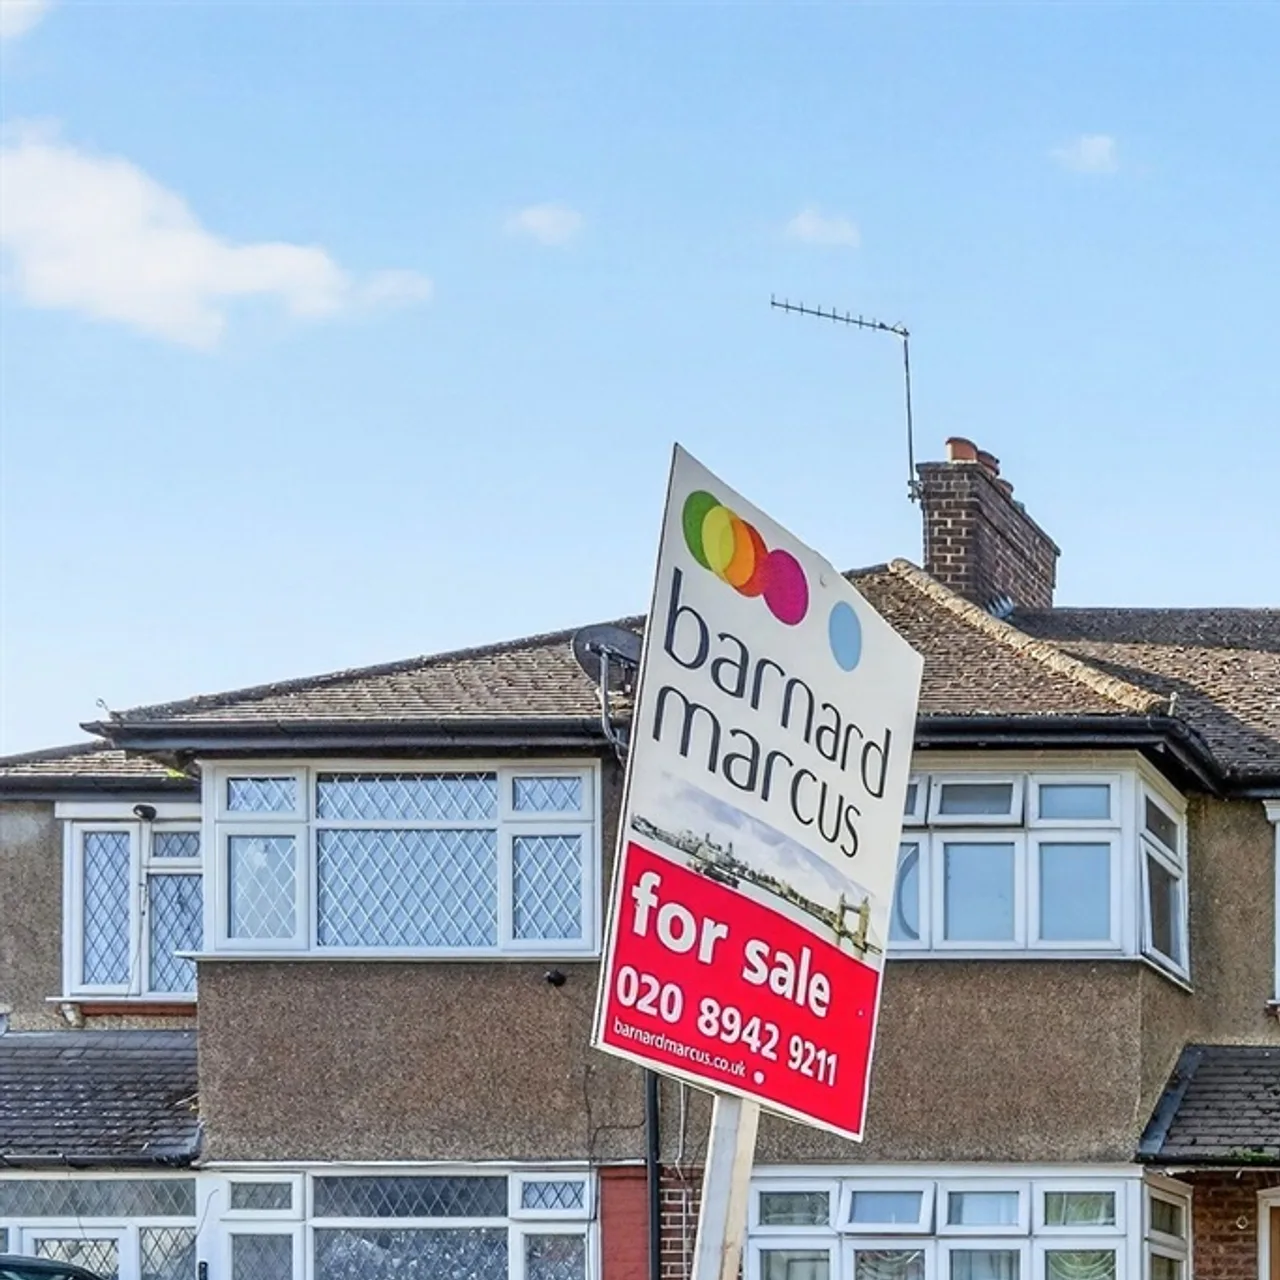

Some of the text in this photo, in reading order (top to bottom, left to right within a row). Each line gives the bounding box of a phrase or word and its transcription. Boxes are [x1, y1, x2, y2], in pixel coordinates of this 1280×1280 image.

[664, 567, 892, 799] barnard
[652, 685, 862, 858] marcus
[631, 871, 831, 1018] for sale
[613, 1017, 747, 1078] barnardmarcus.co.uk
[616, 965, 838, 1088] 020 8942 9211
